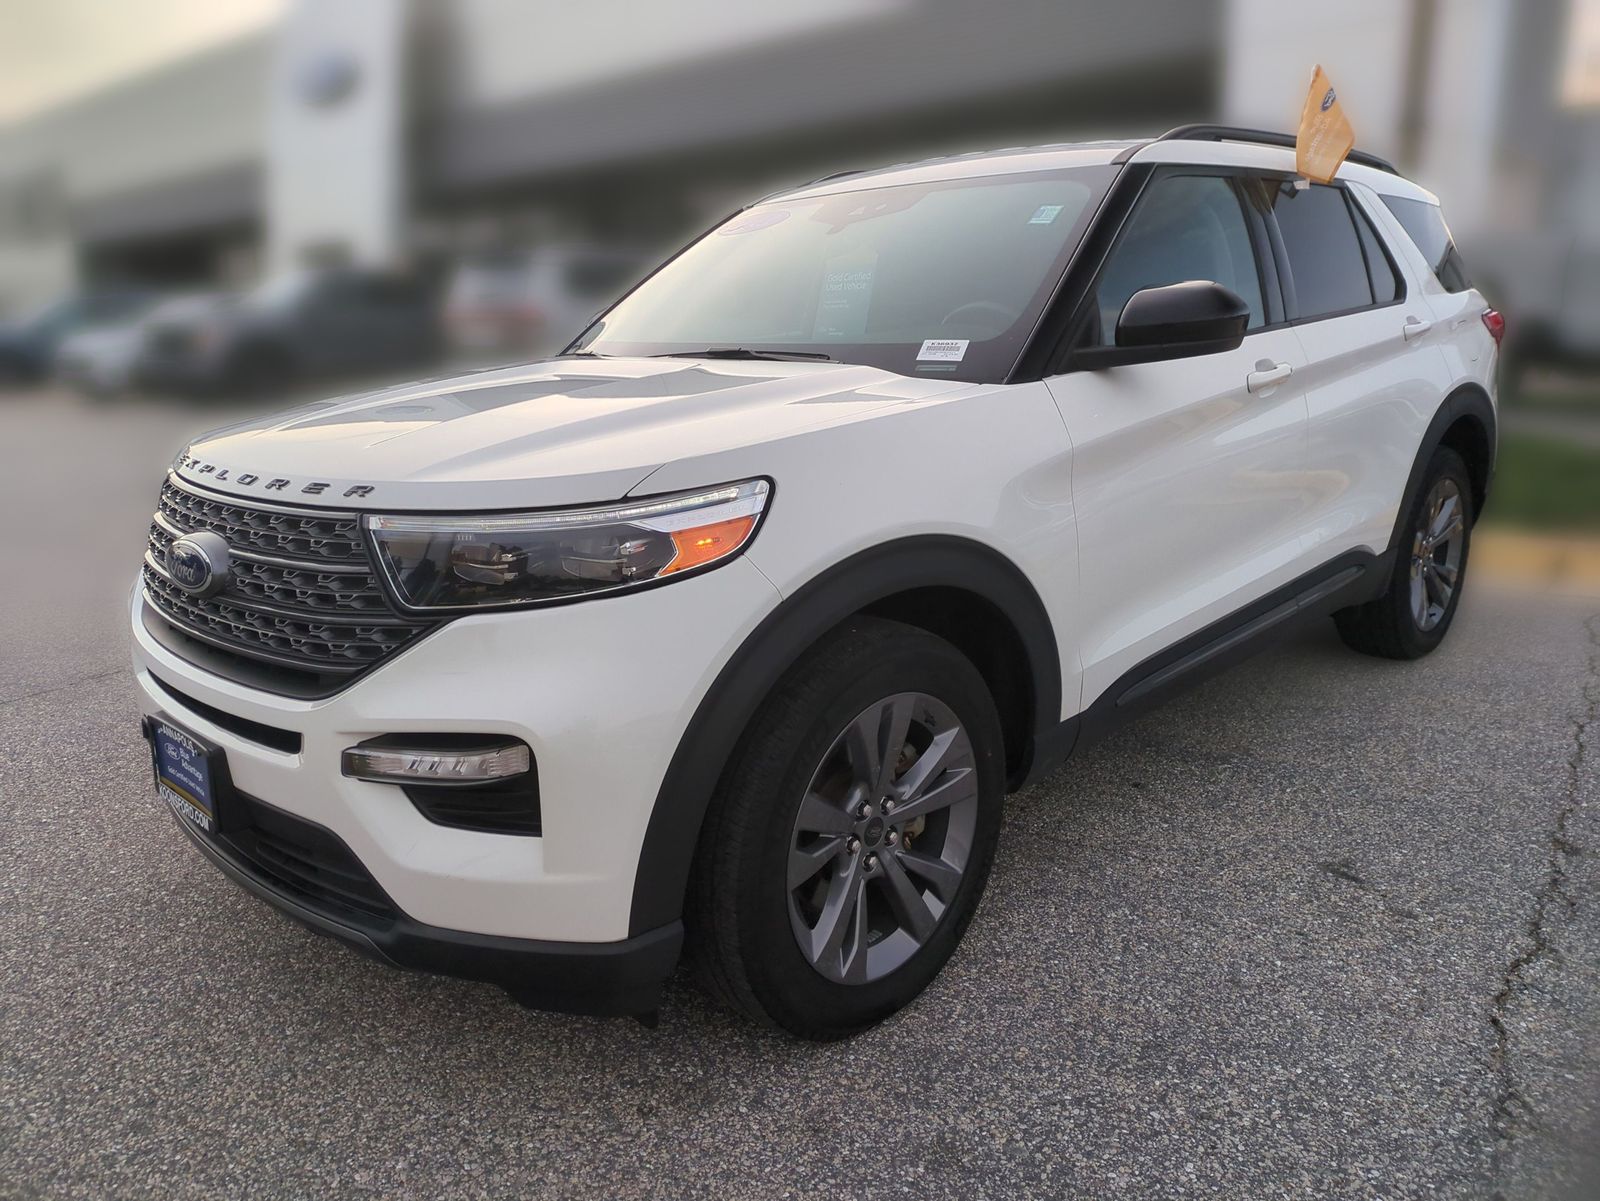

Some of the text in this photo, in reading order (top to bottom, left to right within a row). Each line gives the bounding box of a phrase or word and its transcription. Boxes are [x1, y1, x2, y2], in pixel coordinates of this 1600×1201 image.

[179, 454, 375, 498] EXPLORER
[171, 549, 197, 582] Ford
[162, 724, 194, 751] ANNAPOLIS
[160, 785, 210, 831] KOONSFORD.COM
